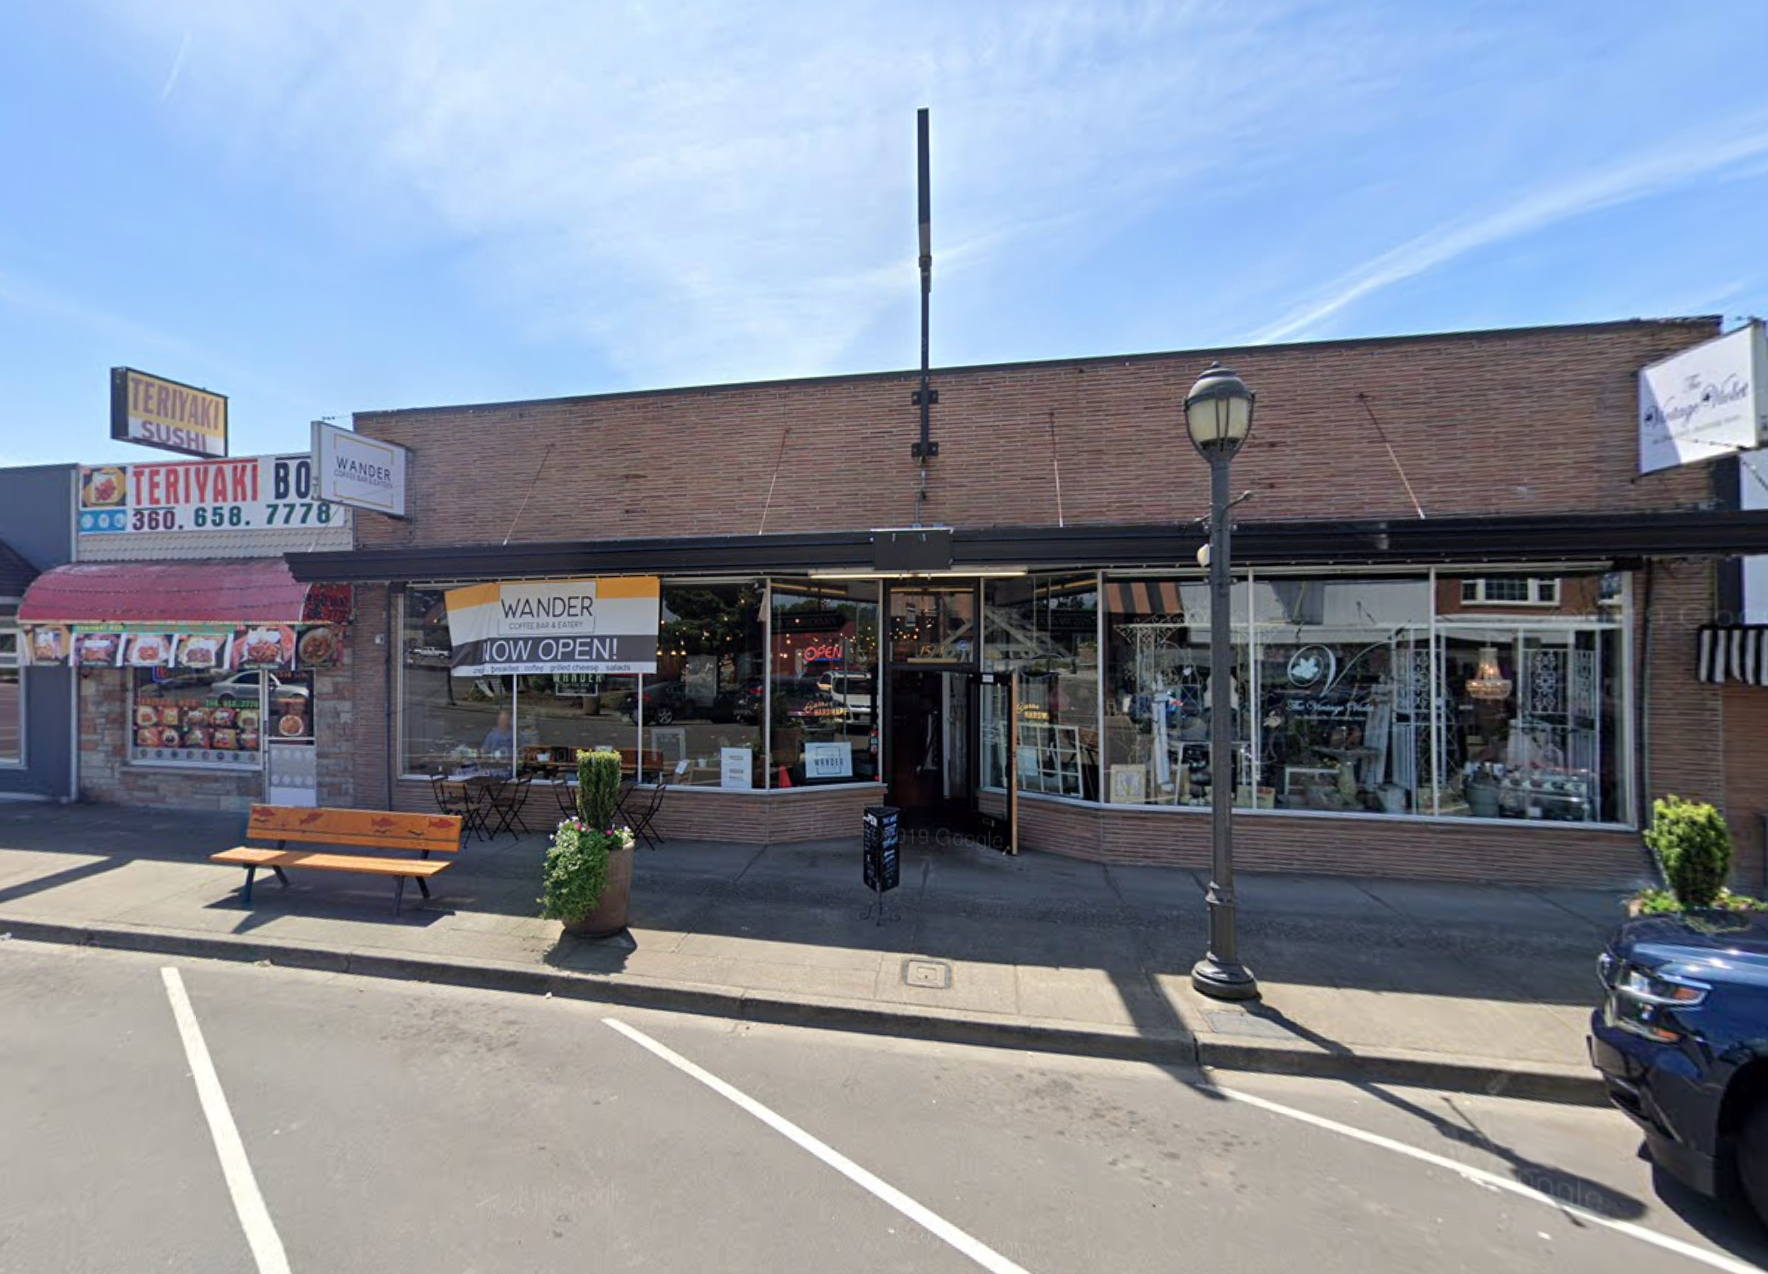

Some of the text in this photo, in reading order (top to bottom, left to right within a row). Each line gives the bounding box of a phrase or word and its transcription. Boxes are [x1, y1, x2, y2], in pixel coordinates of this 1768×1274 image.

[131, 377, 220, 431] TERIYAKI
[141, 419, 207, 454] SUSHI
[336, 455, 392, 481] WANDER
[133, 460, 311, 505] TERIYAKI BO
[133, 501, 331, 531] 360. 658. 7778
[501, 596, 593, 619] WANDER
[509, 621, 583, 630] COFFEE BAR & EATERY
[538, 638, 618, 661] OPEN!
[804, 646, 843, 661] OPEN
[524, 665, 544, 673] coffee
[550, 663, 571, 672] grilled
[572, 663, 599, 672] cheese
[605, 662, 631, 671] salads
[814, 758, 843, 767] WANDER
